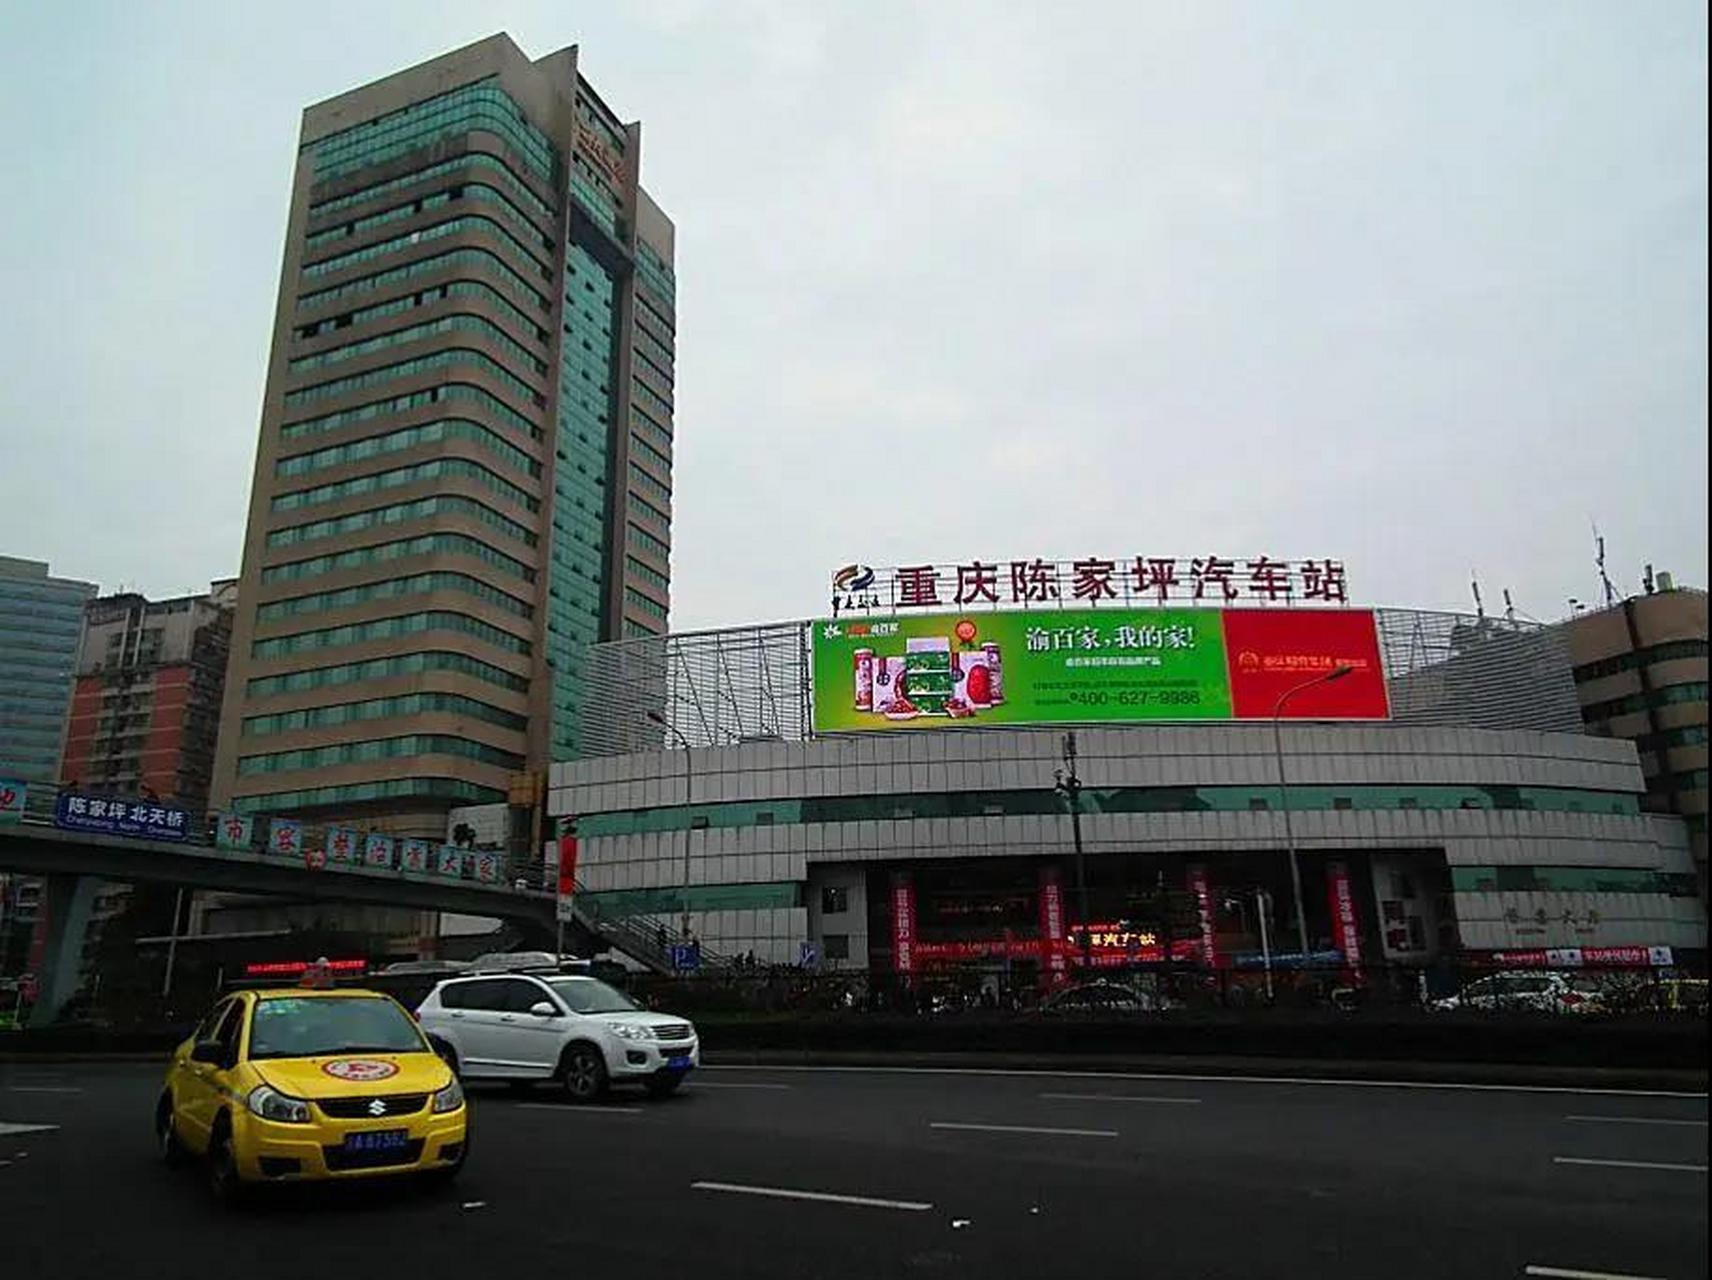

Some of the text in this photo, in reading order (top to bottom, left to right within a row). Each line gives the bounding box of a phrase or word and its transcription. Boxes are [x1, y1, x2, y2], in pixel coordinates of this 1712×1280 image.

[895, 555, 1345, 607] 重庆陈家坪汽车站
